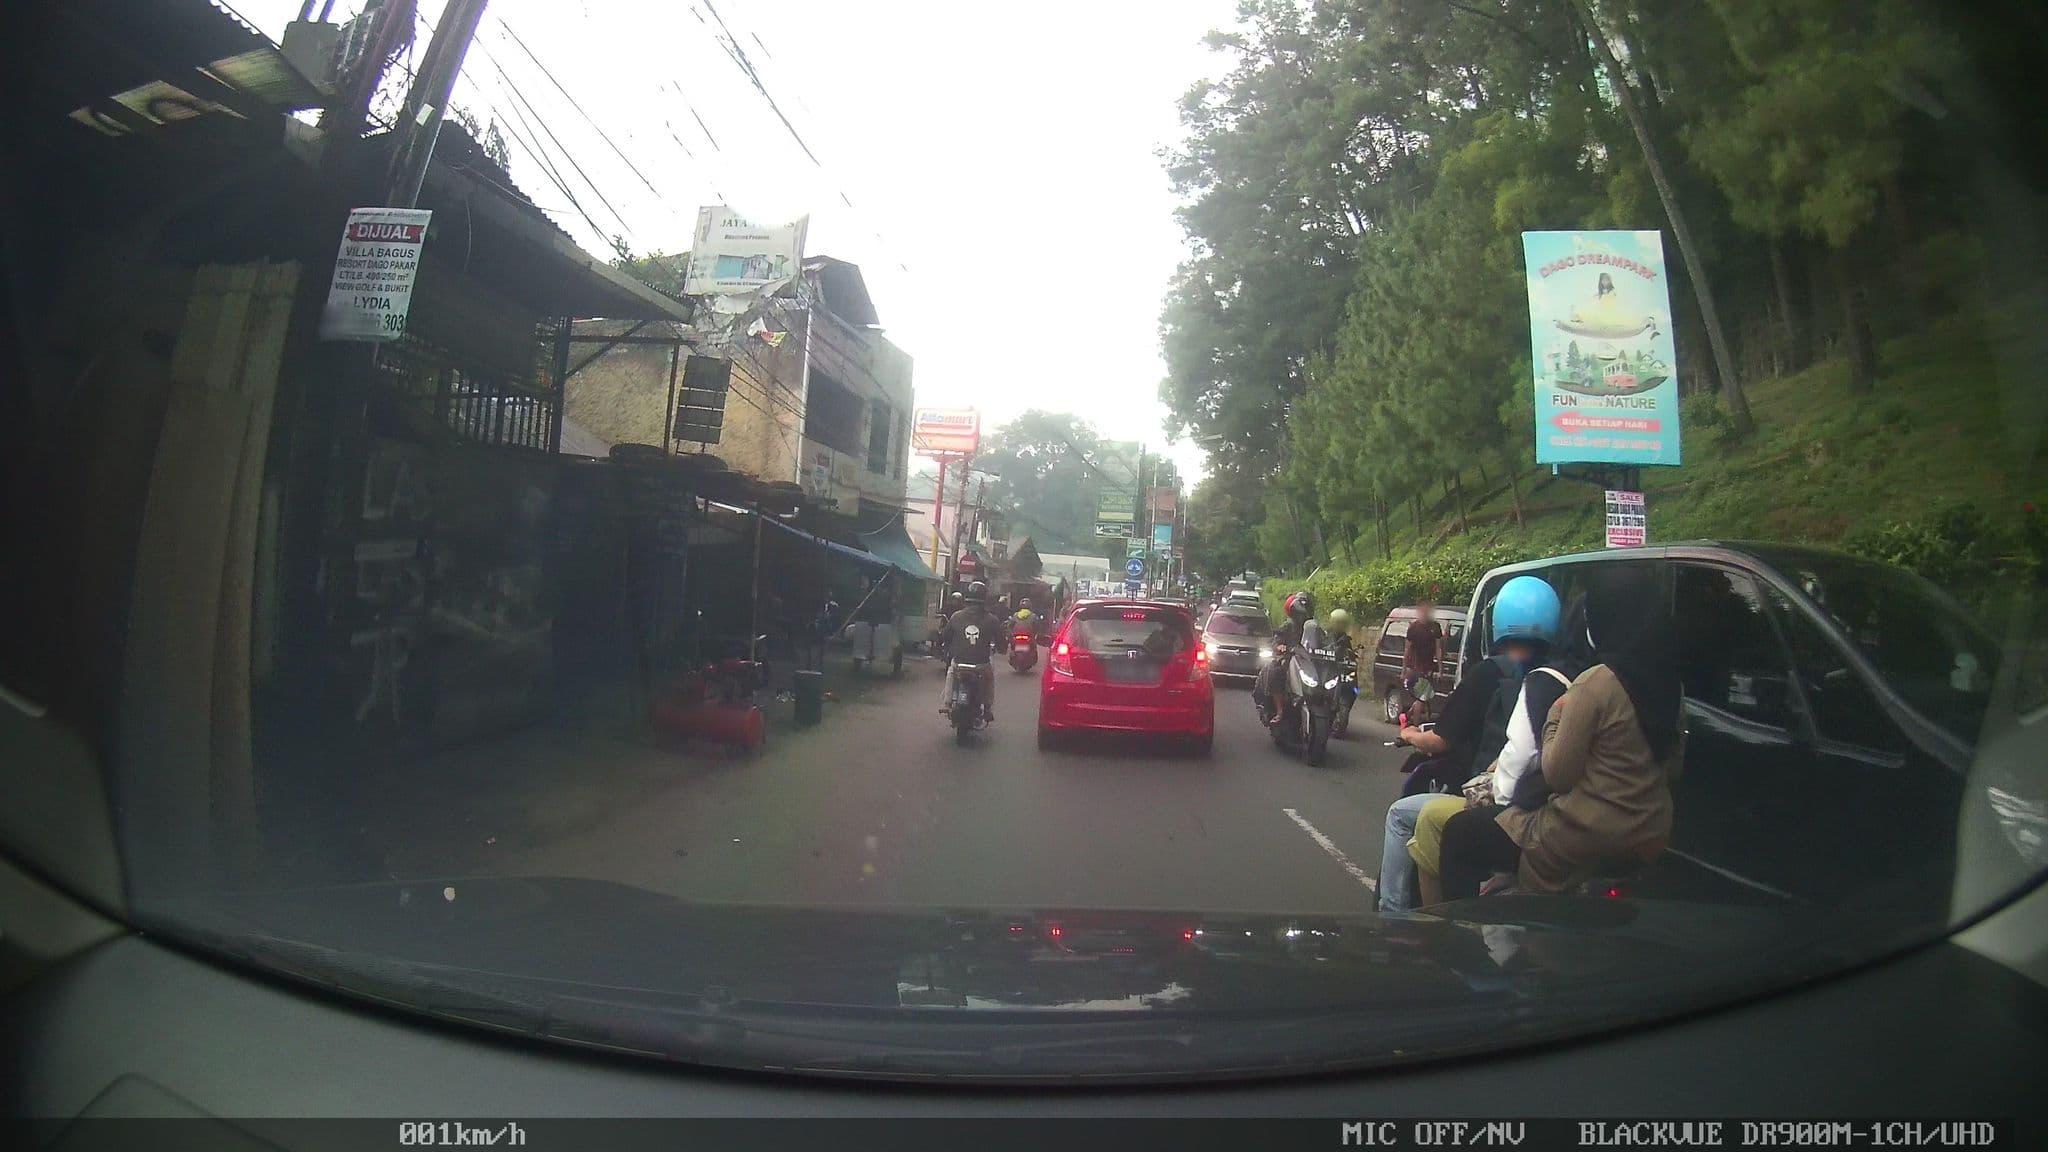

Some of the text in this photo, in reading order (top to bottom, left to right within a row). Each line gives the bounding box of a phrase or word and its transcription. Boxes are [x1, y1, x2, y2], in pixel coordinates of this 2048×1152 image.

[356, 224, 411, 240] DIJUAL
[346, 246, 415, 259] VILLA BAGUS
[337, 259, 367, 269] RESORT
[390, 261, 416, 271] PAKAR
[1539, 253, 1657, 281] DAGO DREAMPARK
[335, 282, 354, 291] VIEW
[355, 282, 377, 292] GOLF
[384, 284, 410, 293] BUKIT
[353, 296, 392, 311] LYDIA
[1552, 394, 1577, 406] FUN
[1605, 397, 1656, 409] NATURE
[920, 411, 974, 424] Alfamart
[1561, 417, 1589, 427] BUKA
[1624, 420, 1648, 430] HARI
